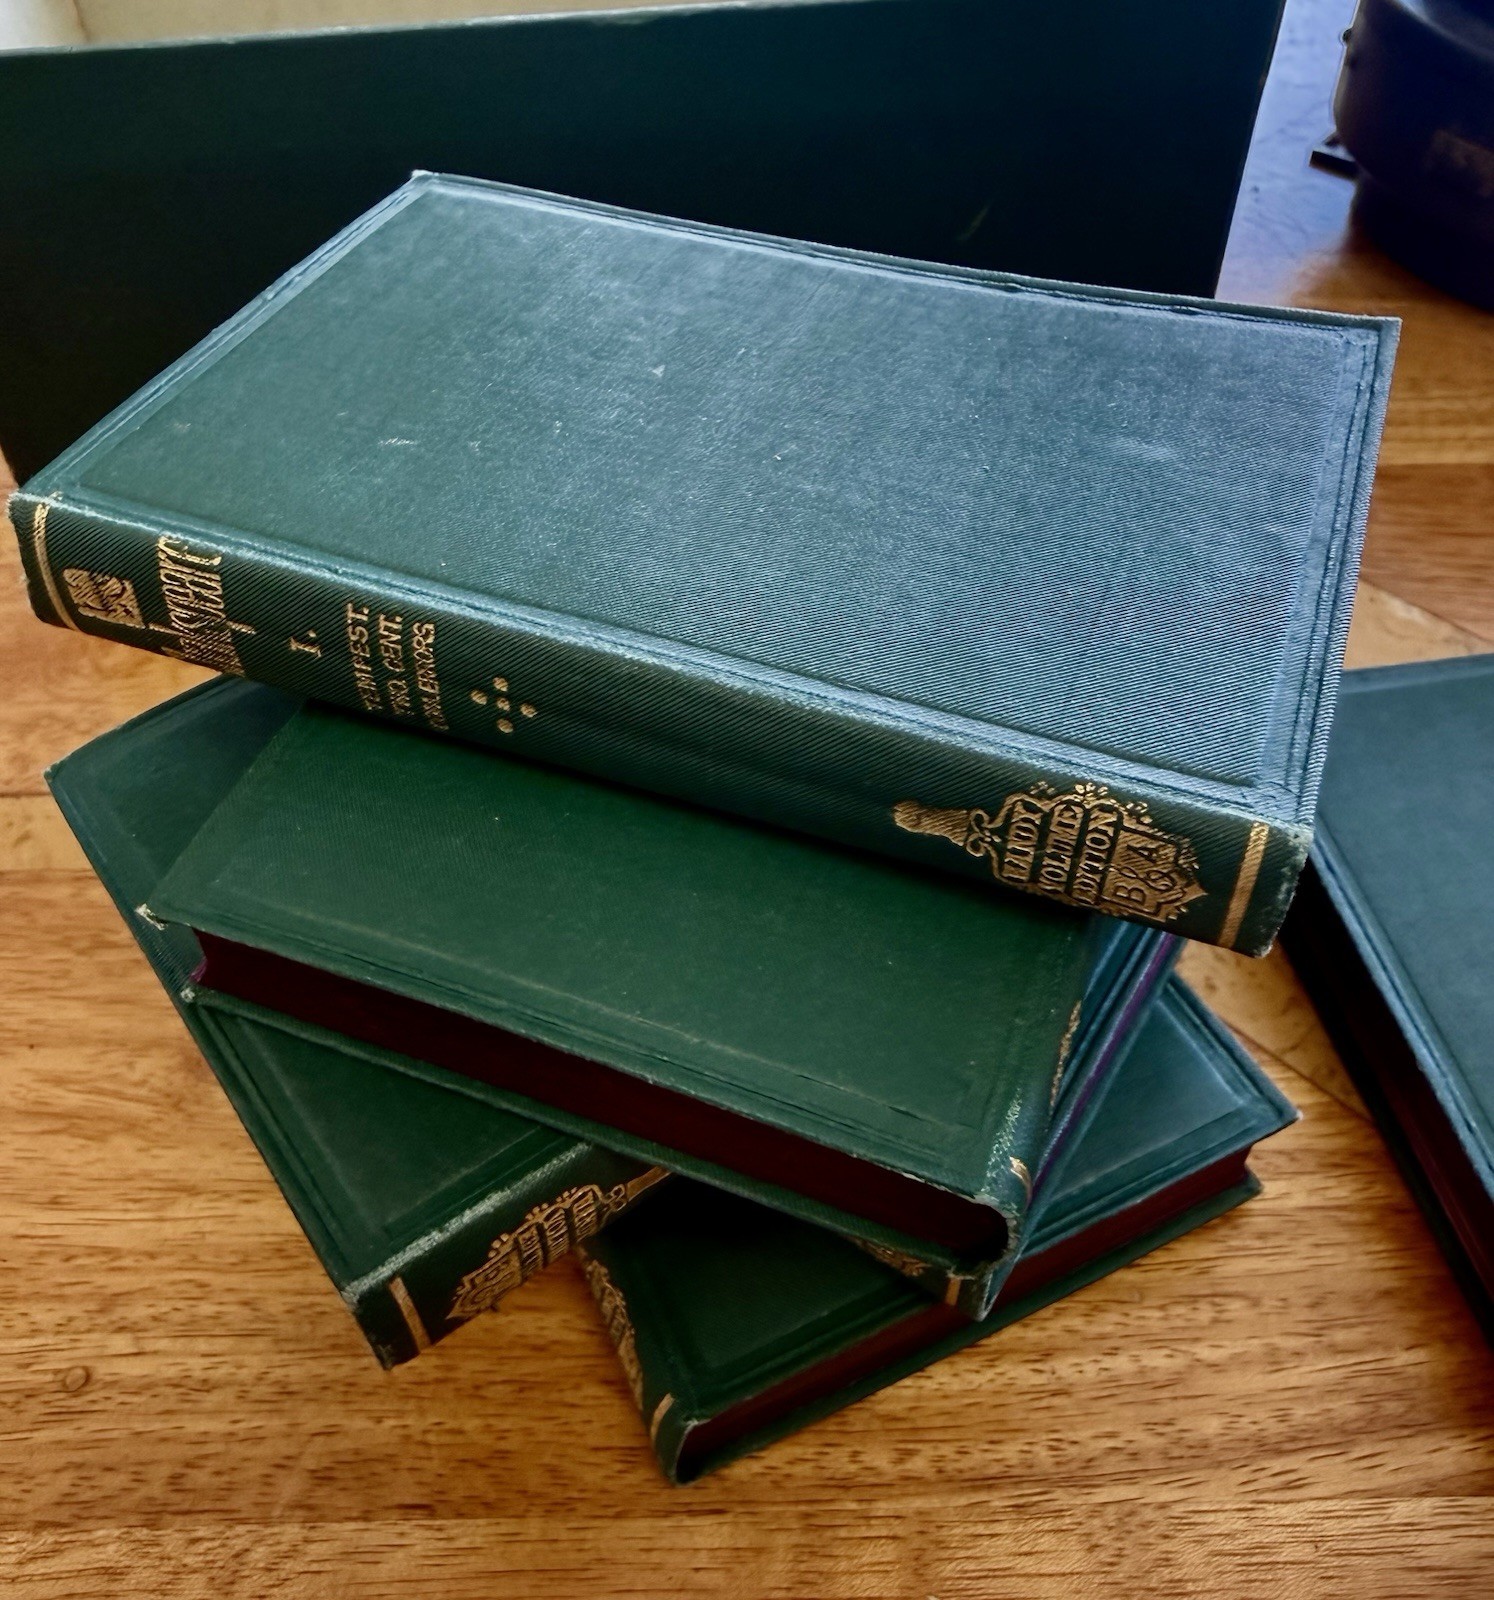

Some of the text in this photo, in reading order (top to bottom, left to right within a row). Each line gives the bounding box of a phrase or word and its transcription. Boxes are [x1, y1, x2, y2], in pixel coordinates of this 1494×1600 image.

[346, 602, 383, 711] TEMPEST.
[1001, 800, 1042, 883] HANDY
[1038, 803, 1084, 894] VOLUME
[1071, 808, 1118, 905] EDITION
